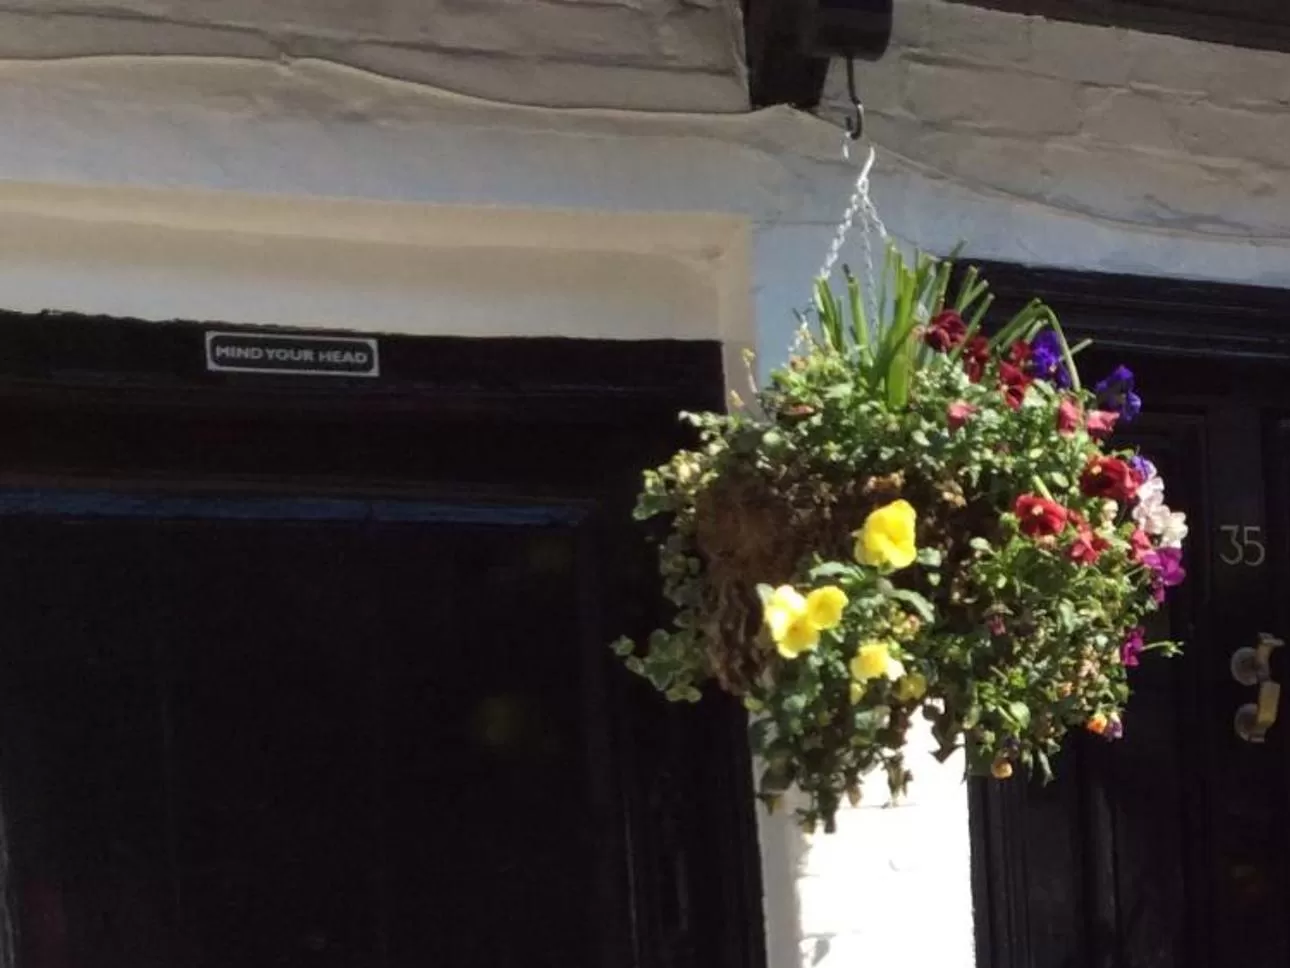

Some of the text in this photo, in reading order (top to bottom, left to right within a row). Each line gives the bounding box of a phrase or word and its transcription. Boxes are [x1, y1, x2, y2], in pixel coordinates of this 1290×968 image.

[214, 345, 368, 365] MIND YOUR HEAD
[1220, 525, 1265, 566] 35
